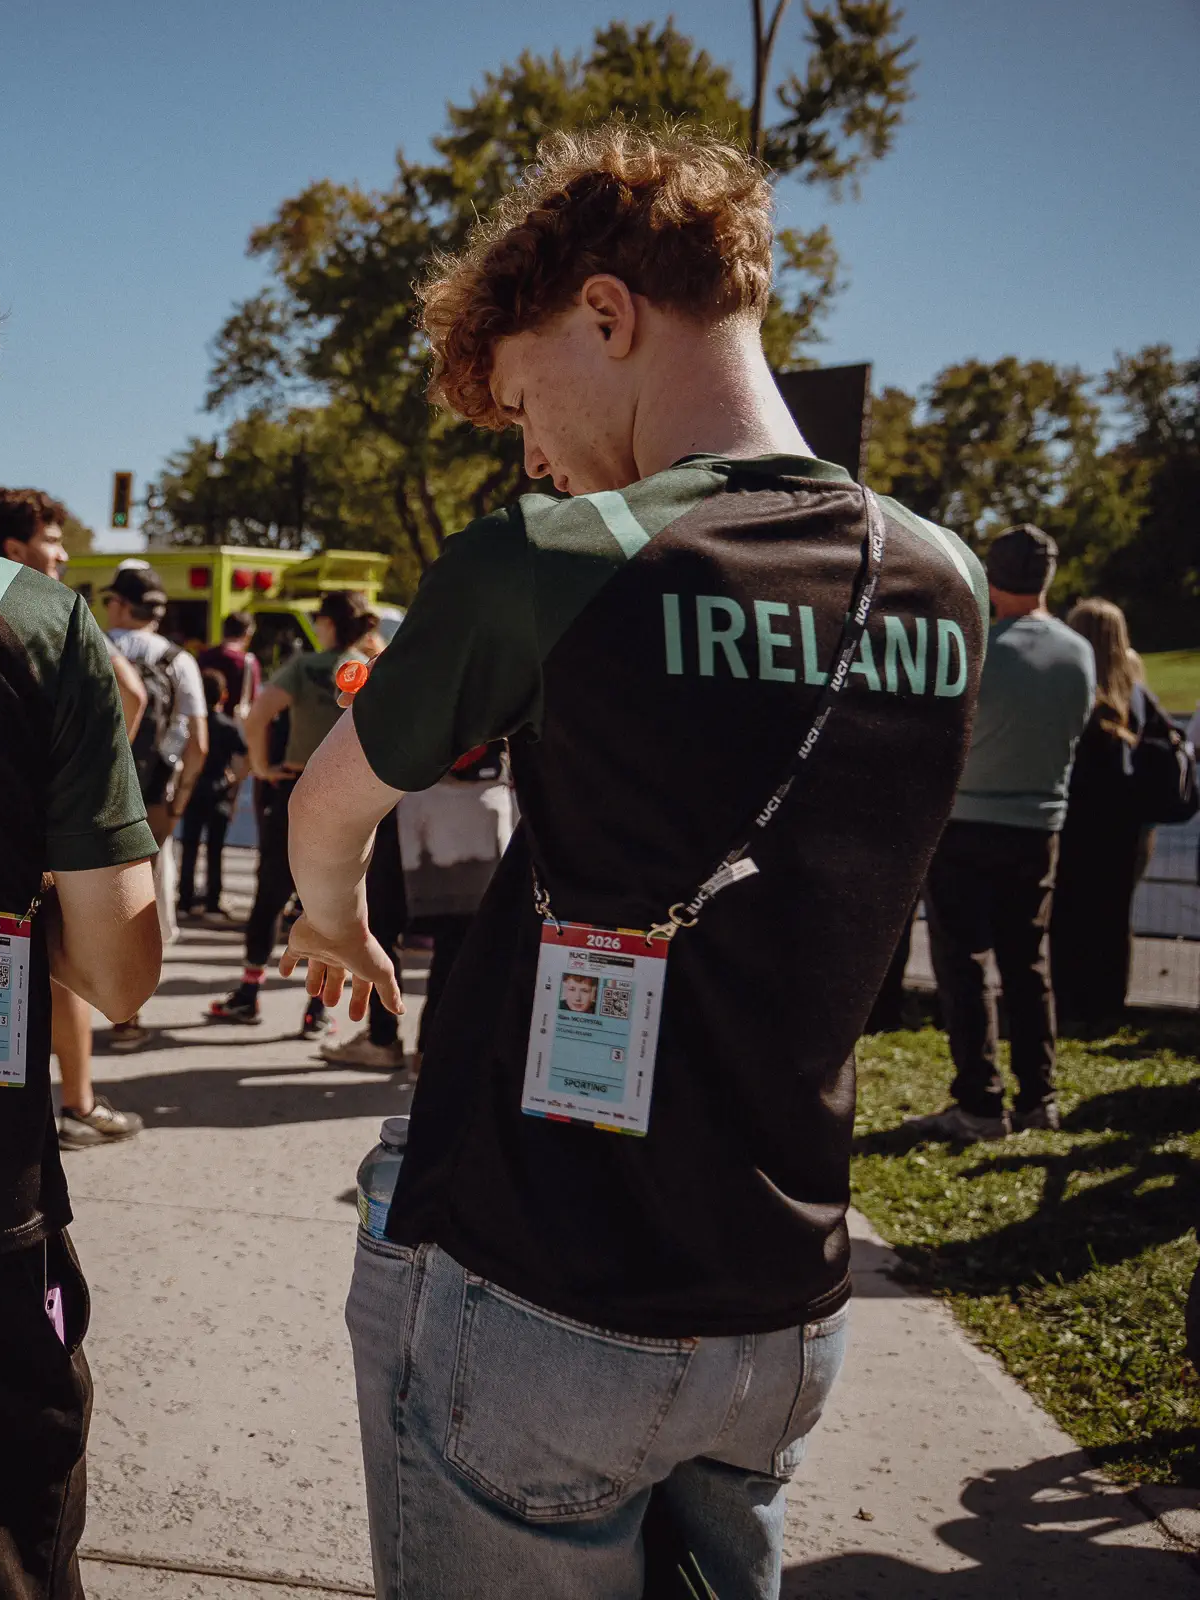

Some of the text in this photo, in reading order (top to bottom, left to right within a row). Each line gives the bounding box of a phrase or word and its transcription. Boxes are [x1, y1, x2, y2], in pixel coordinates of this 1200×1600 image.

[856, 595, 872, 623] UCI
[662, 593, 968, 698] IRELAND
[832, 659, 850, 688] UCI
[800, 726, 820, 755] UCI
[759, 795, 782, 824] UCI
[586, 934, 621, 949] 2026
[614, 1050, 621, 1059] 3
[563, 1078, 608, 1093] SPORTING
